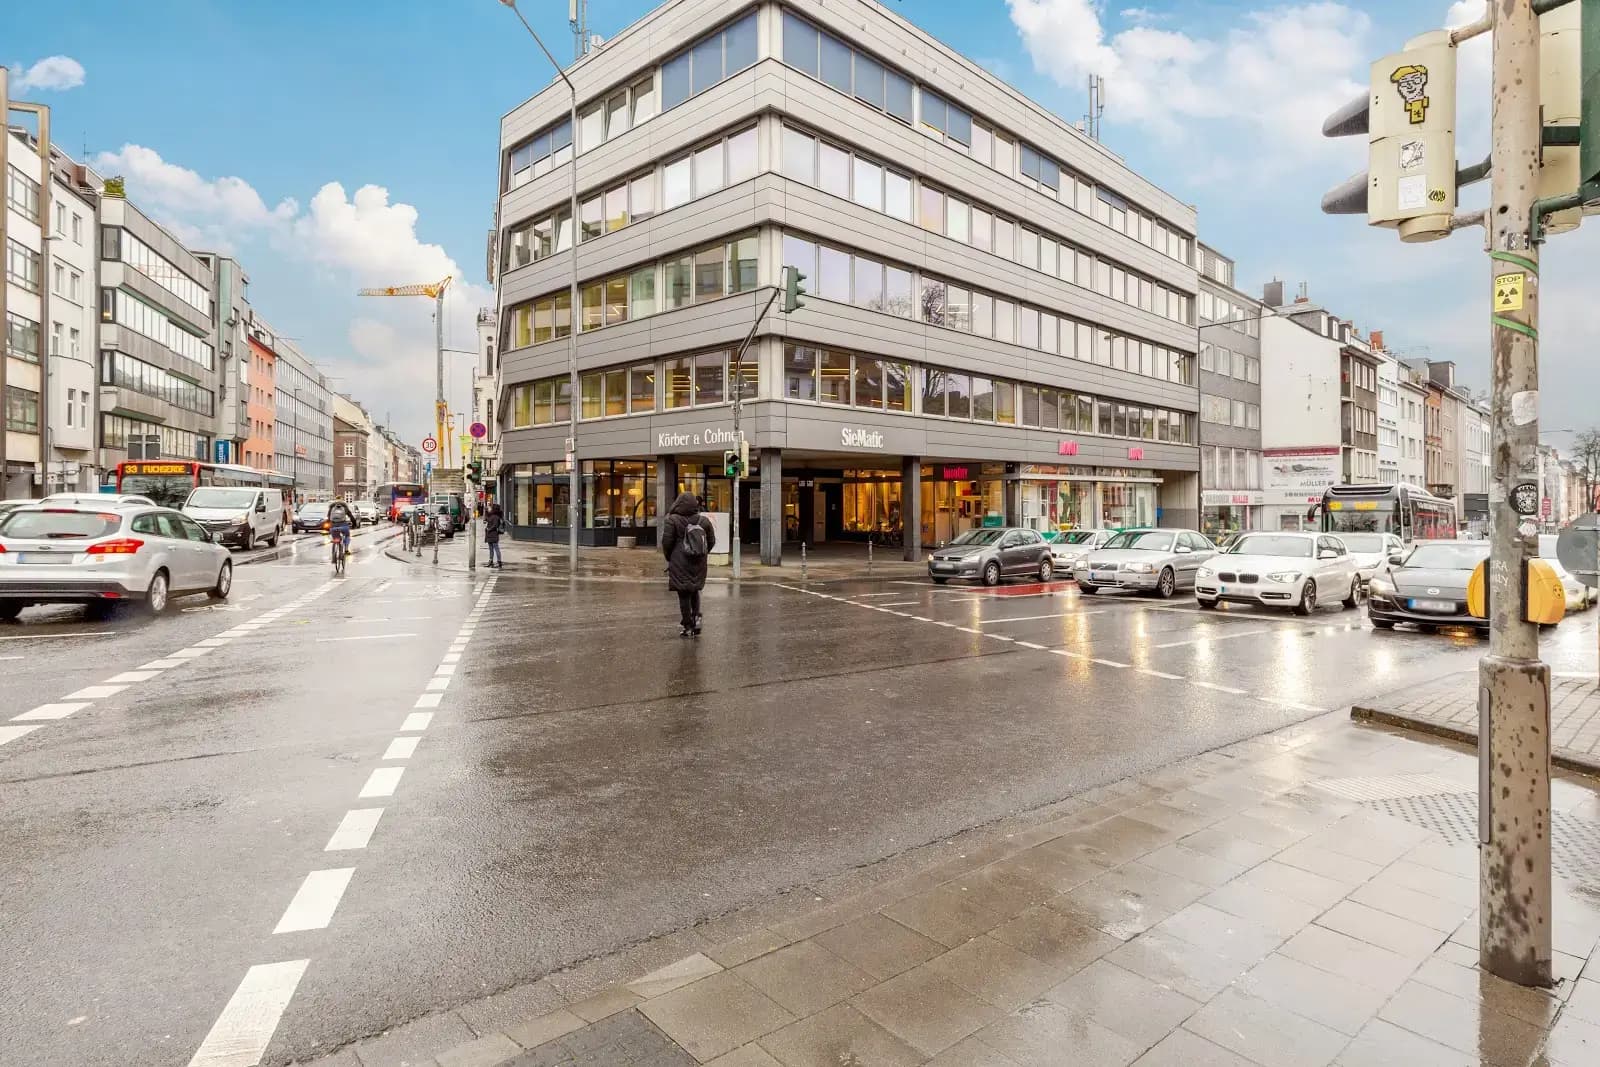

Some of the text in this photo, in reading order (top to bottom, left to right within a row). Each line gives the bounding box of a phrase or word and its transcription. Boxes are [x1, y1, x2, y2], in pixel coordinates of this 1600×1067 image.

[1496, 275, 1521, 285] STOP
[658, 432, 690, 447] Körber
[841, 427, 884, 449] SieMatic
[425, 441, 435, 449] 30
